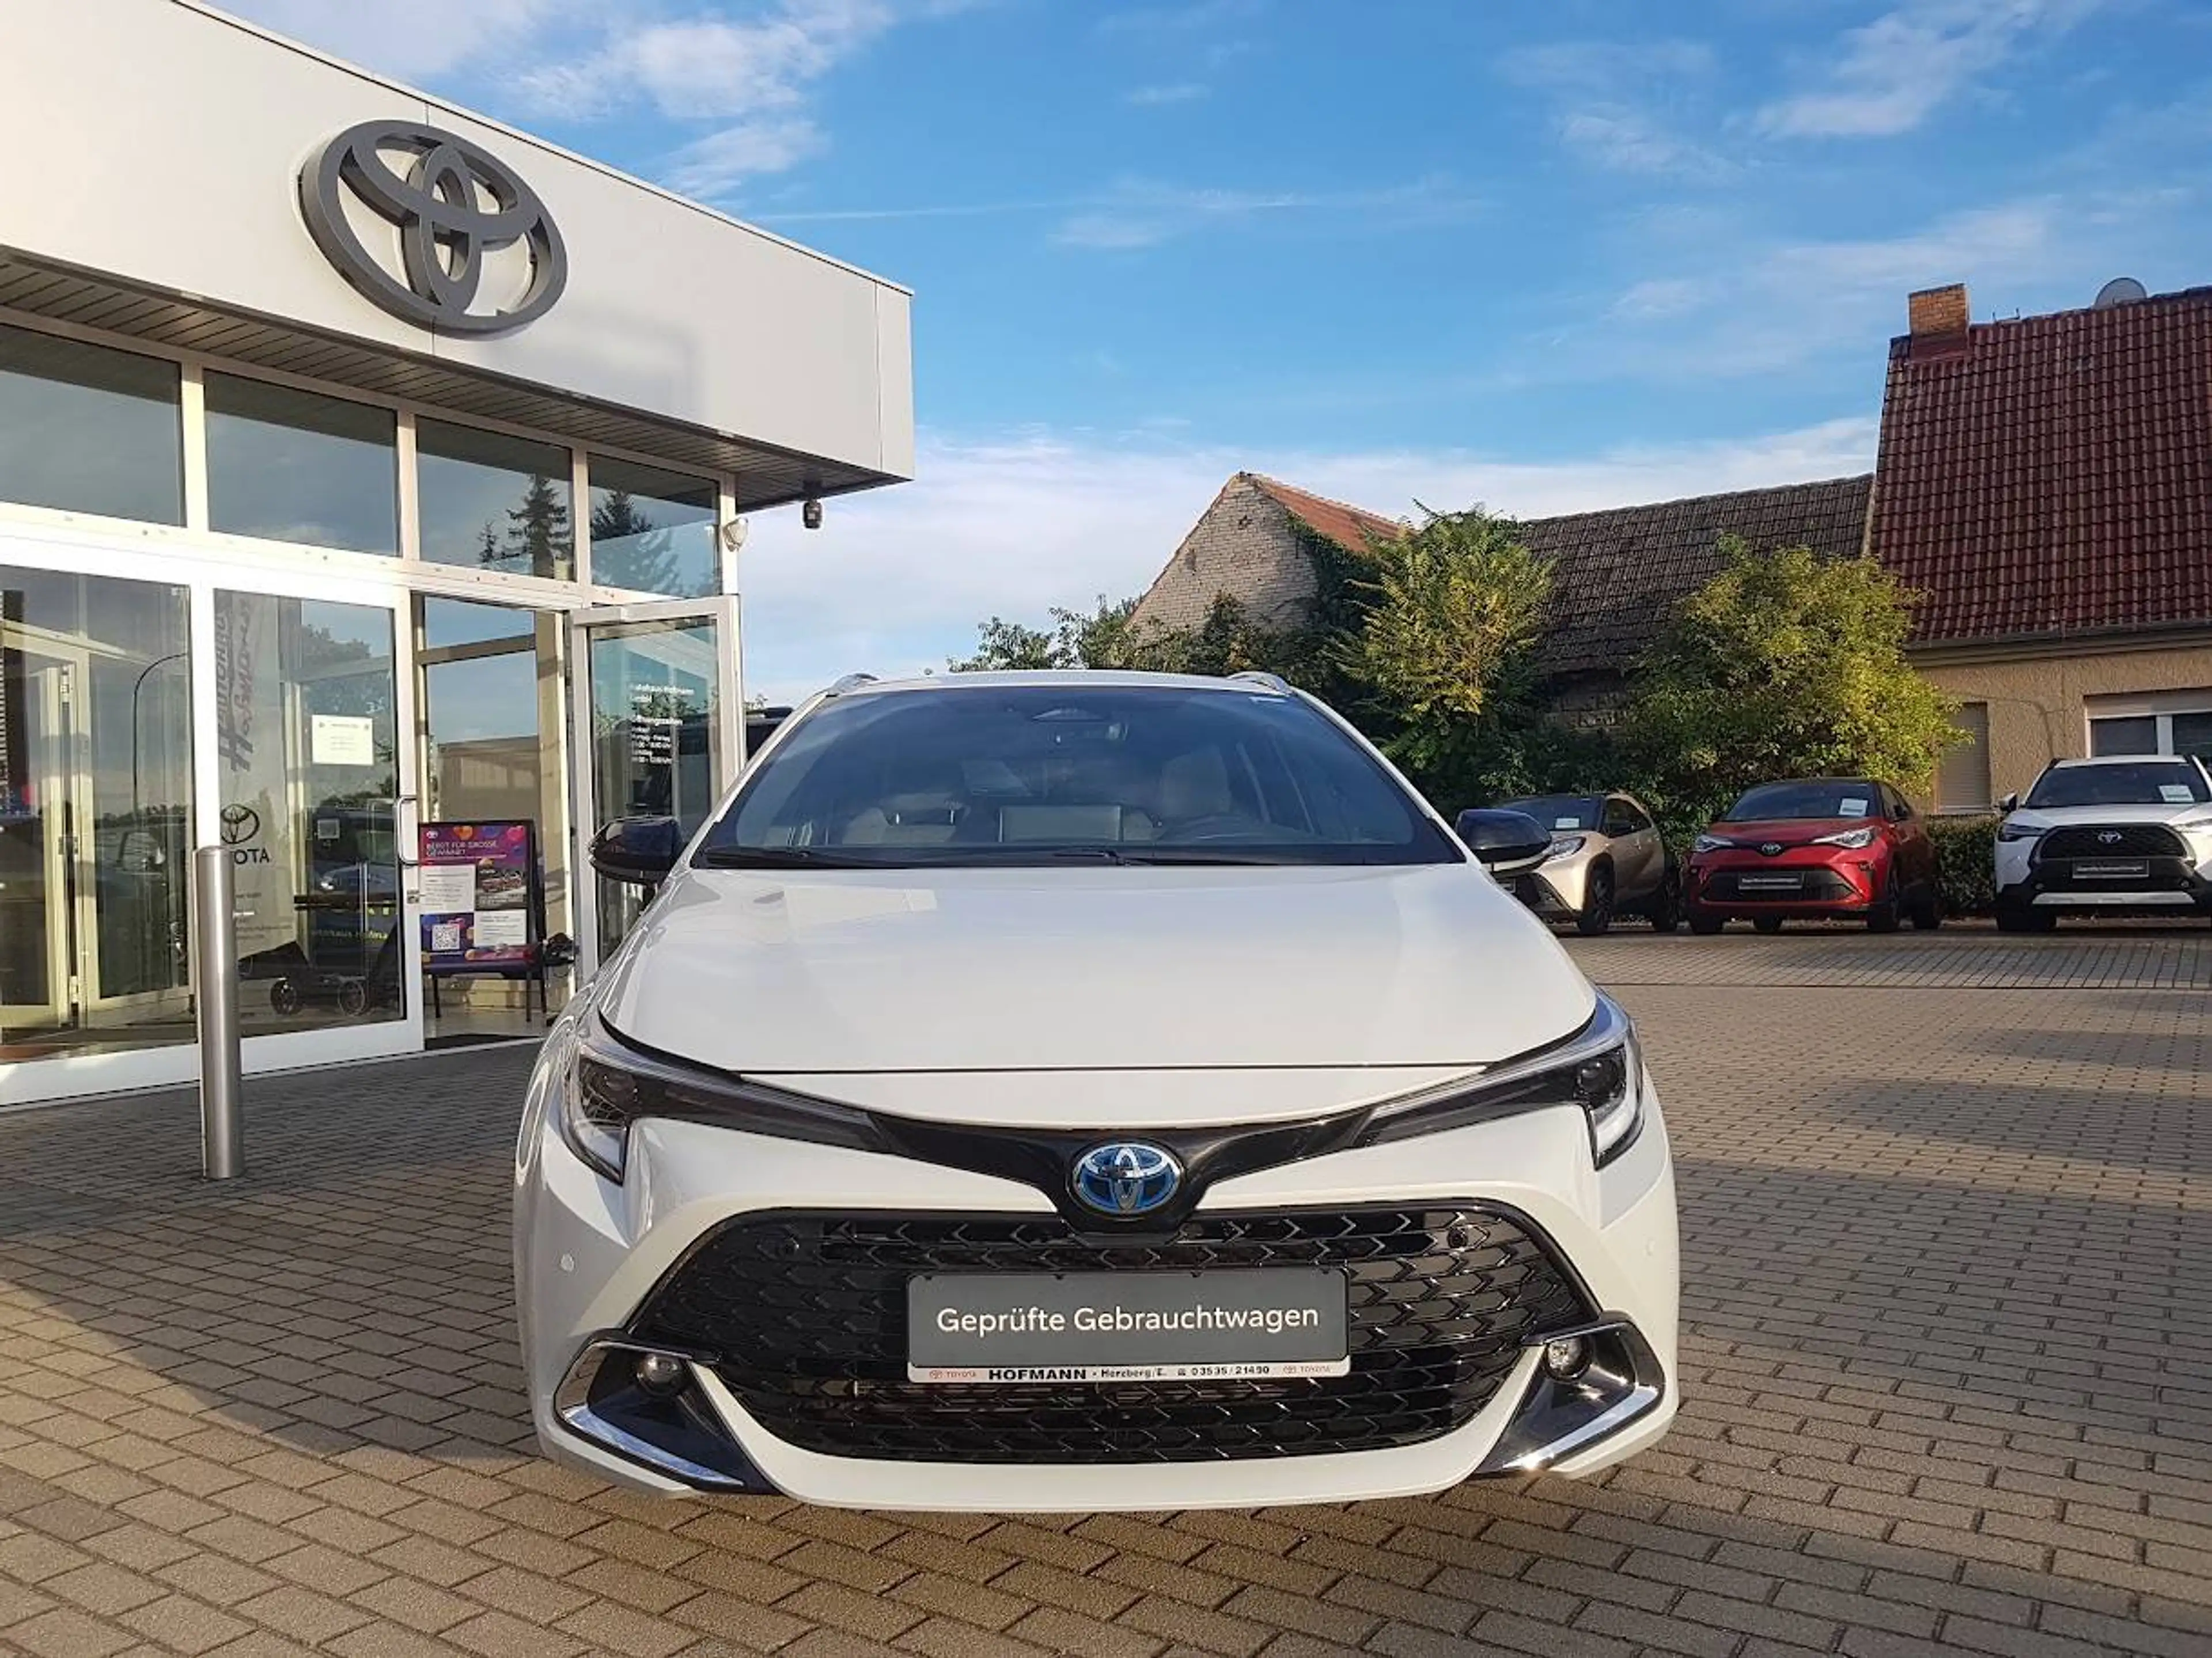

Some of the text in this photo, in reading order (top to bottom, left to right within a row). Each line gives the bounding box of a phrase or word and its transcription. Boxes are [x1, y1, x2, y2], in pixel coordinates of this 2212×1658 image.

[230, 848, 270, 864] OTA
[937, 1304, 1319, 1338] Geprüfte Gebrauchtwagen
[988, 1369, 1086, 1380] HOFMANN
